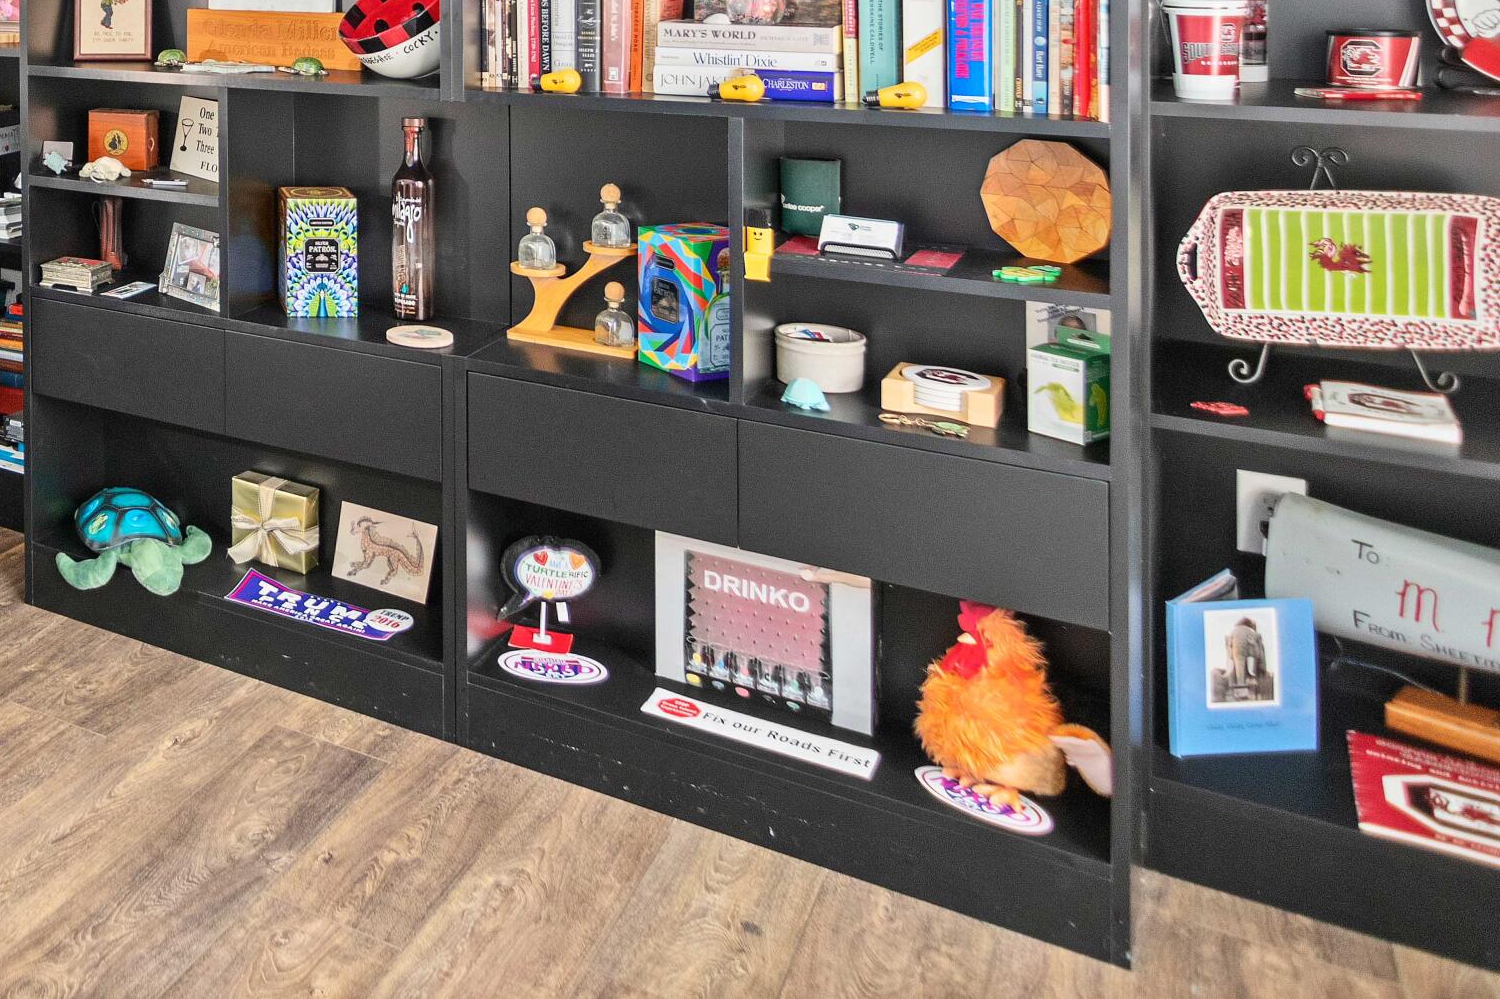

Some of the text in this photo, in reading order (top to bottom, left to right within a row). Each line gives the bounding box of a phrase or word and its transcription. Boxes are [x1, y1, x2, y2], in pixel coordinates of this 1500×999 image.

[202, 19, 338, 41] Glenda Miller
[541, 9, 549, 43] BEFORE
[663, 28, 756, 40] MARY'S WORLD
[207, 41, 276, 58] American
[403, 31, 434, 54] COCKY
[878, 43, 884, 51] OF
[542, 45, 550, 71] DAWN
[692, 52, 778, 68] Whistlin' Dixie
[1036, 50, 1045, 63] Bart
[660, 74, 809, 90] JOHN CHARLESTON
[200, 107, 215, 121] One
[198, 123, 213, 136] Two
[196, 140, 215, 155] Three
[797, 205, 822, 213] cooper
[703, 569, 811, 614] DRINKO
[251, 599, 272, 607] MAKE
[259, 595, 368, 630] PENCE
[380, 609, 410, 621] TRUMP
[374, 615, 401, 629] 2016
[702, 711, 872, 768] Fix our Roads First
